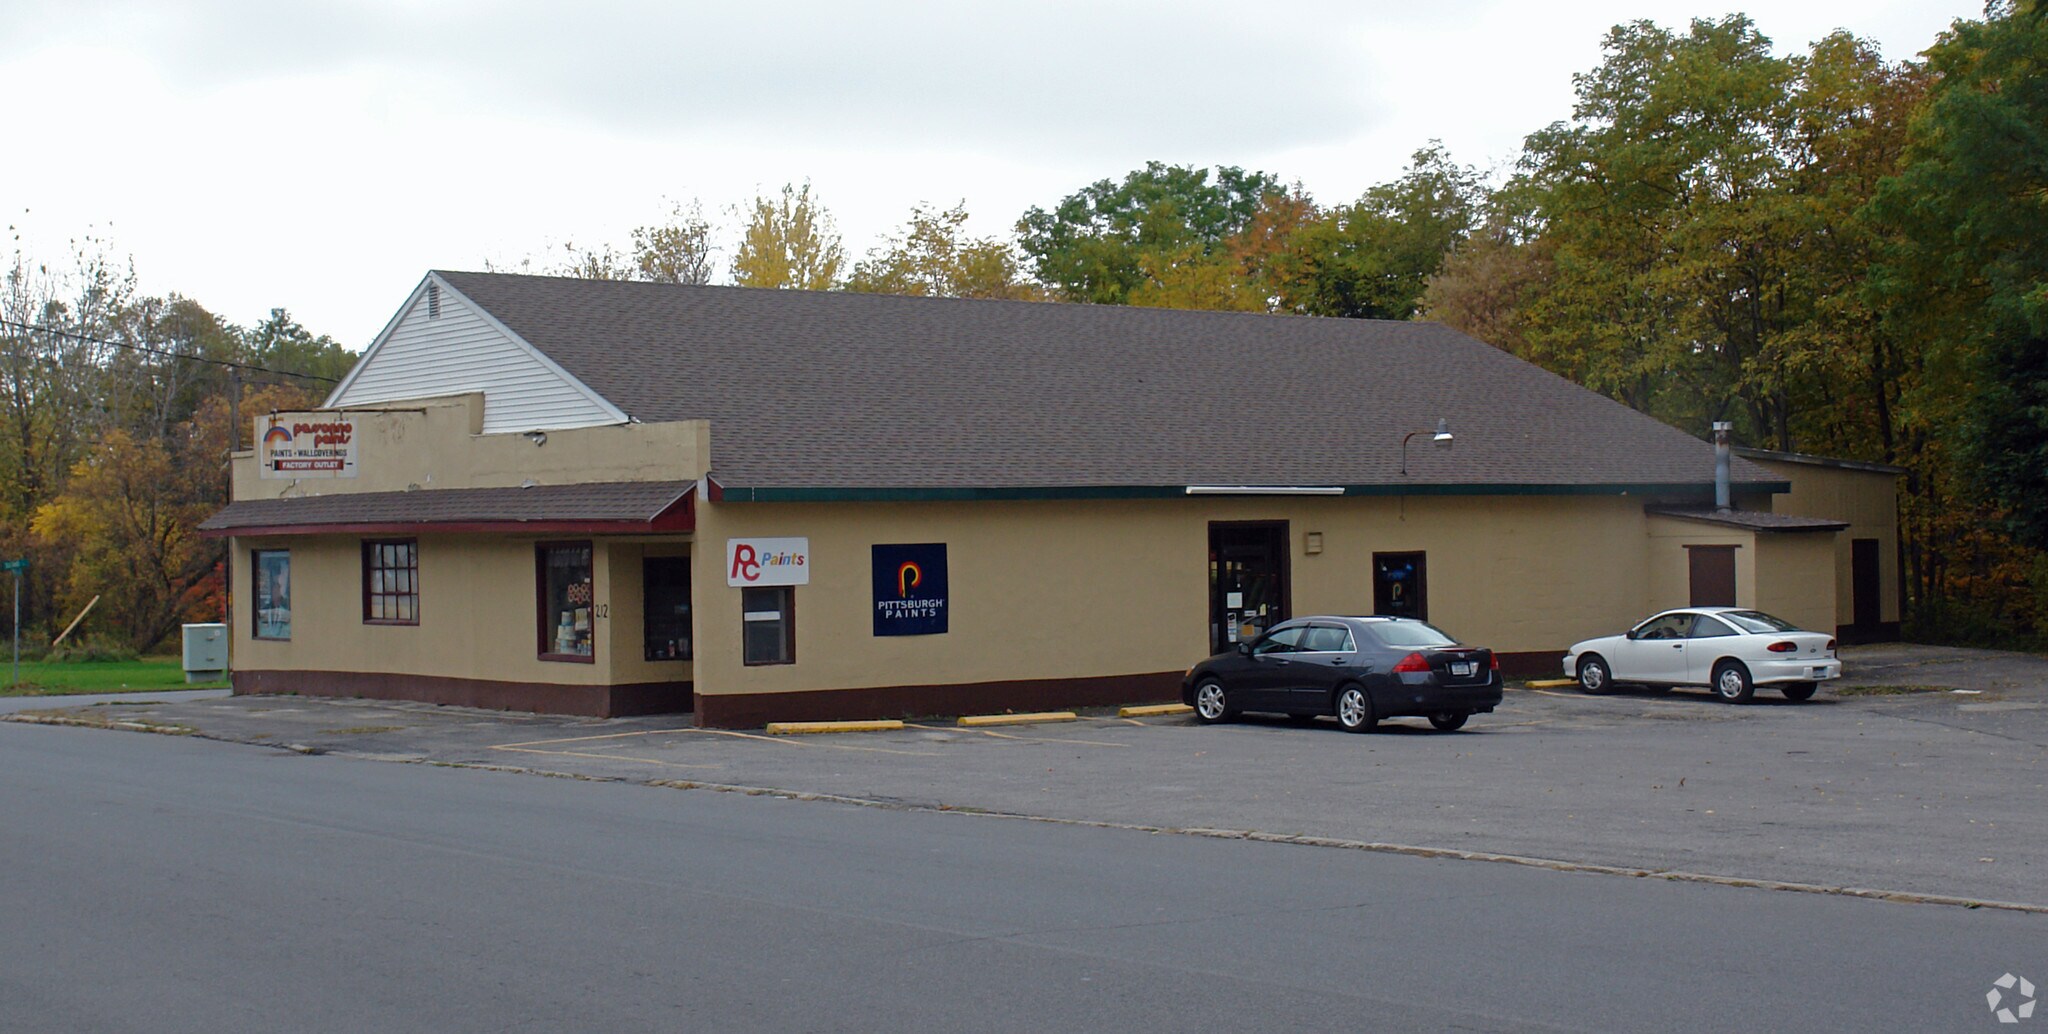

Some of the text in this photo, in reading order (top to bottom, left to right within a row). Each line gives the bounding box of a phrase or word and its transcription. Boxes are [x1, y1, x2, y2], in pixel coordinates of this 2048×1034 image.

[761, 552, 805, 566] Paints
[878, 599, 942, 610] PITTSBURGH
[595, 604, 608, 618] 212
[885, 608, 936, 619] PAINTS
